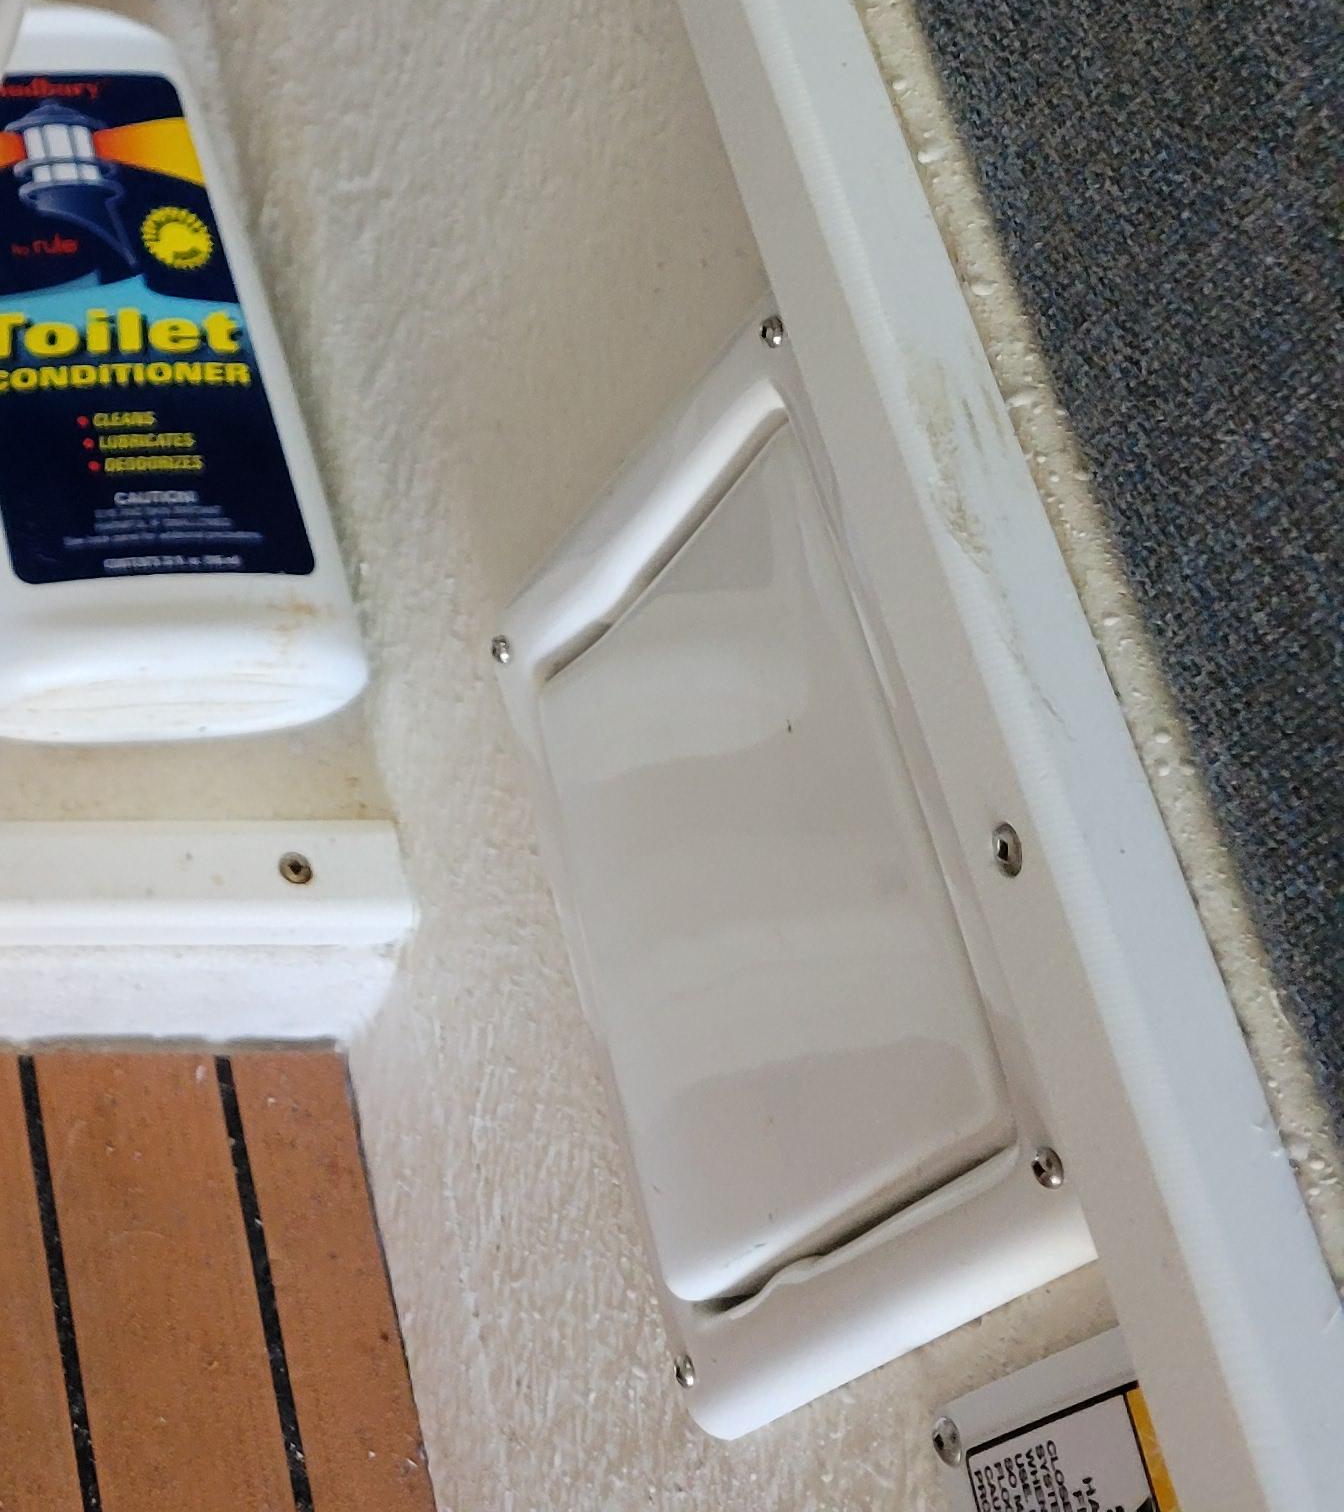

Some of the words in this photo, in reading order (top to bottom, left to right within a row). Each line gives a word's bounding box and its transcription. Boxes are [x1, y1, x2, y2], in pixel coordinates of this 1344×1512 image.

[93, 411, 156, 427] CLEANS
[99, 432, 196, 450] LUBRICATES
[105, 455, 204, 472] DEODORIZES
